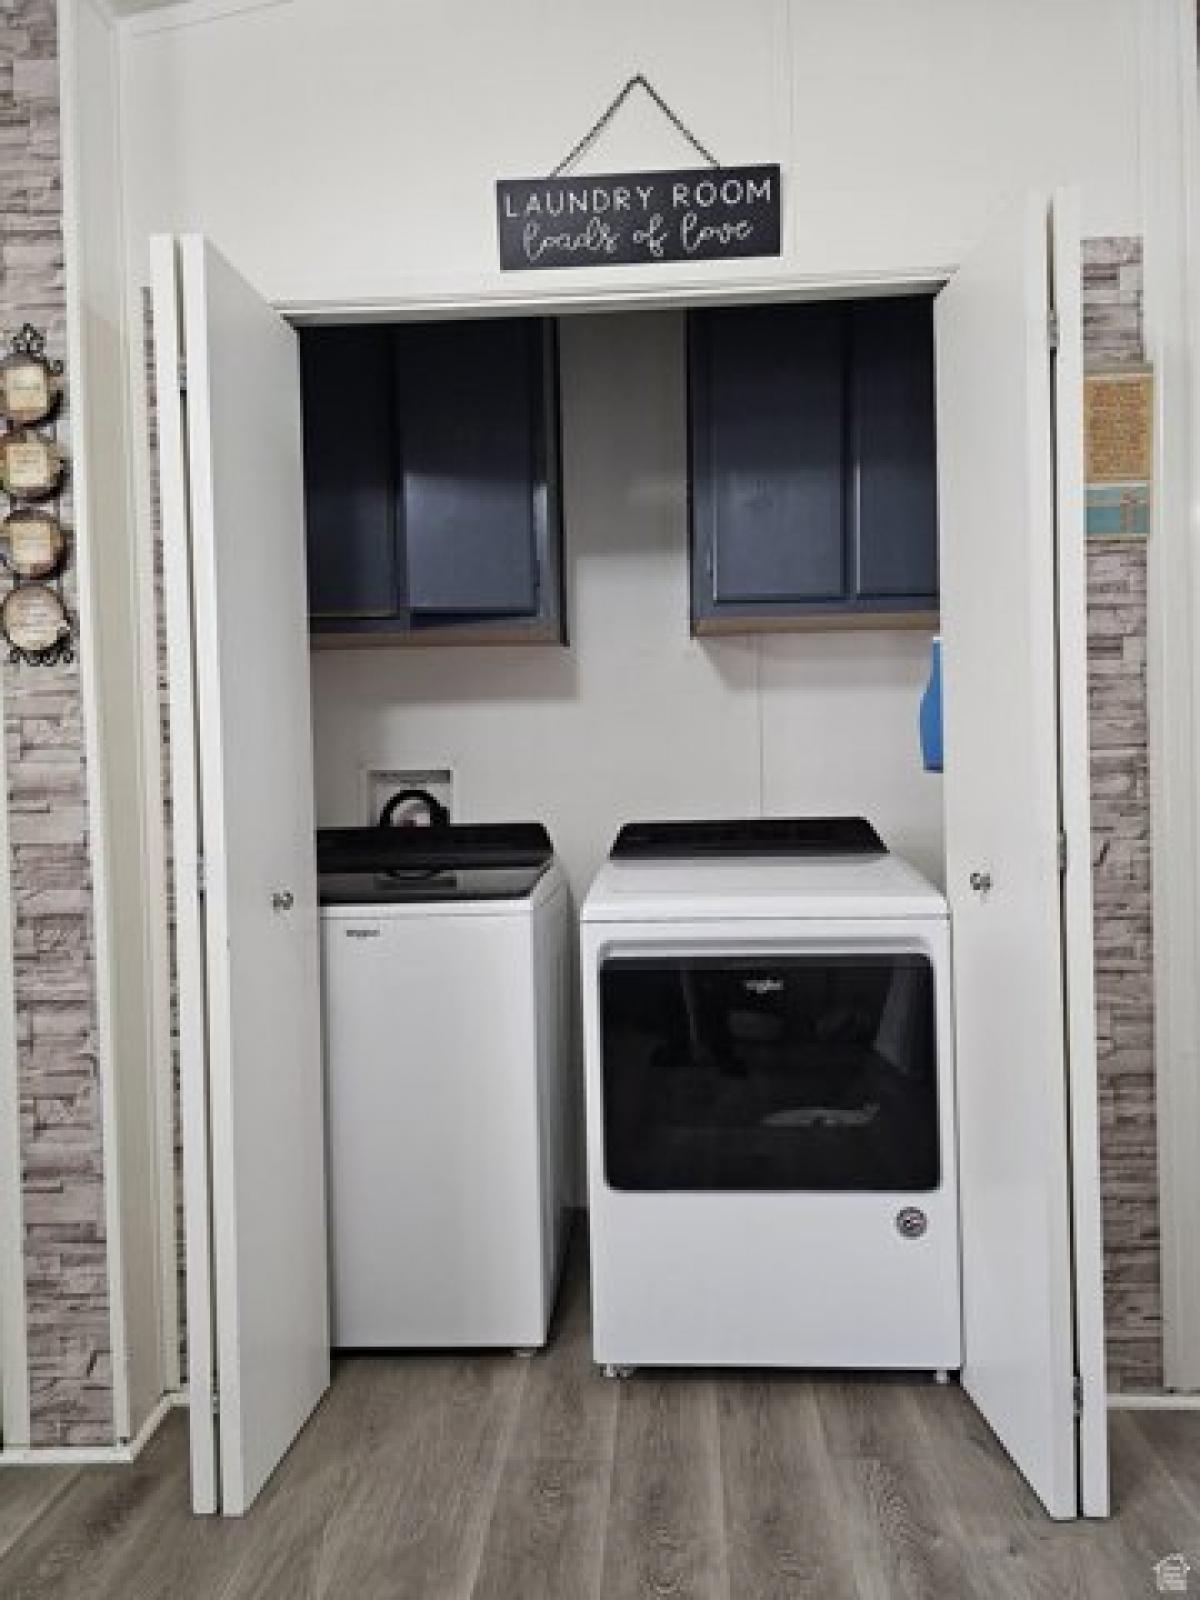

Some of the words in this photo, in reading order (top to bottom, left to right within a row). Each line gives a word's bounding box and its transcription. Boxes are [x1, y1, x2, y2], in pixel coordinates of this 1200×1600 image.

[505, 186, 654, 218] LAUNDRY
[672, 179, 771, 208] ROOM
[633, 213, 667, 257] of
